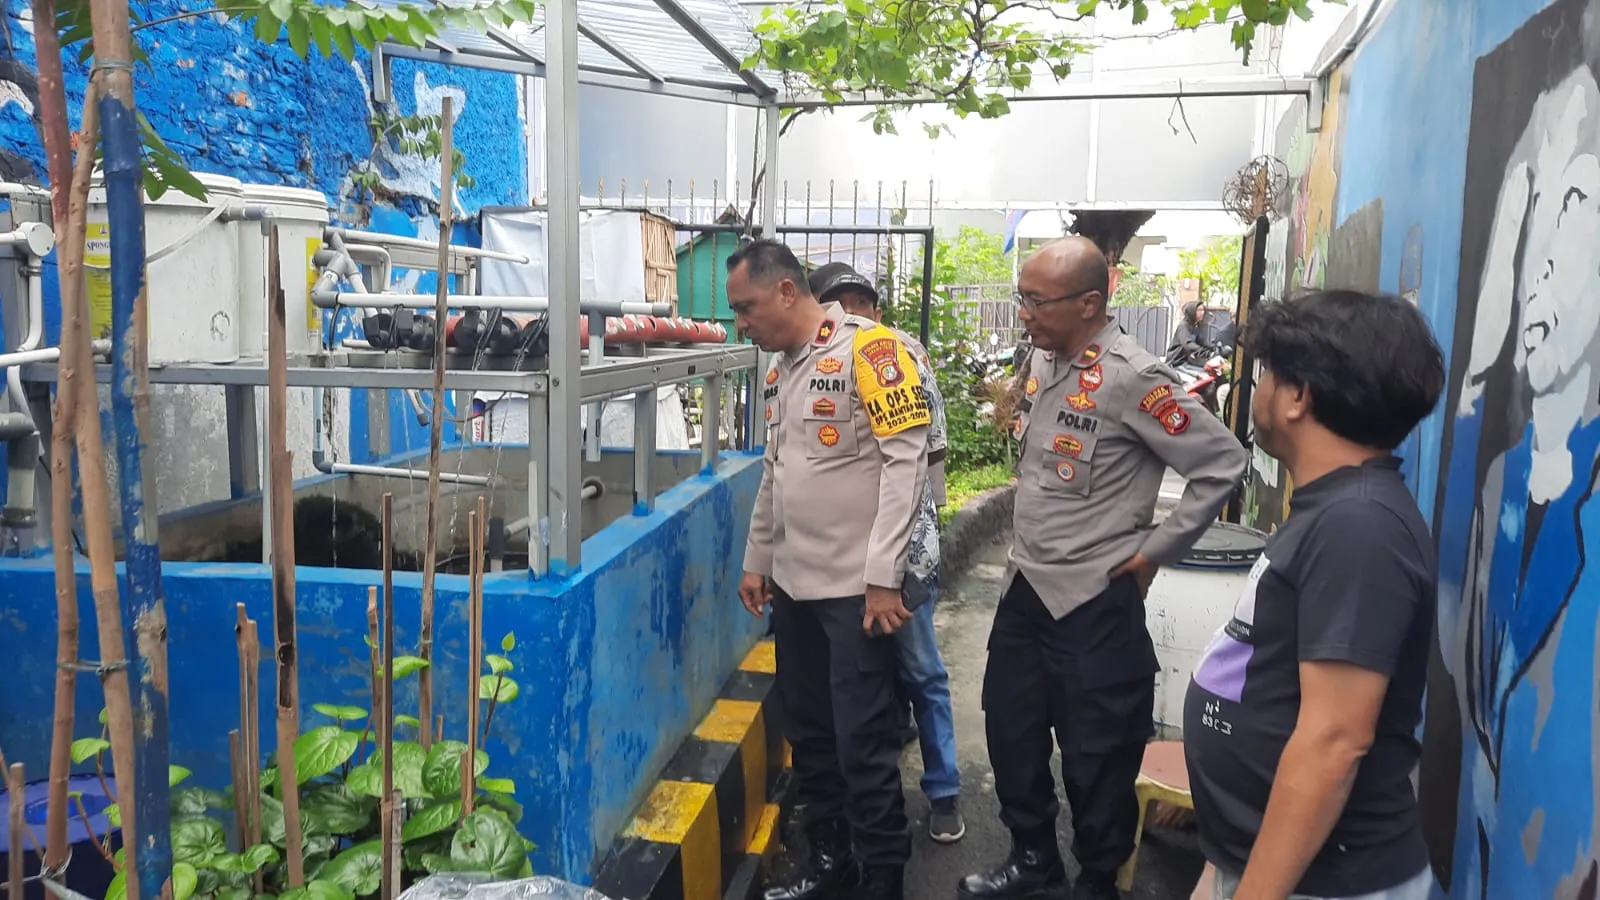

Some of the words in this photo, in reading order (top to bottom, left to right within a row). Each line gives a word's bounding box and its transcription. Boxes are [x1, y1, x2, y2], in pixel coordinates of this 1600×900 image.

[809, 378, 846, 393] POLRI
[866, 399, 883, 417] KA
[886, 388, 909, 408] OPS
[1057, 410, 1098, 432] POLRI
